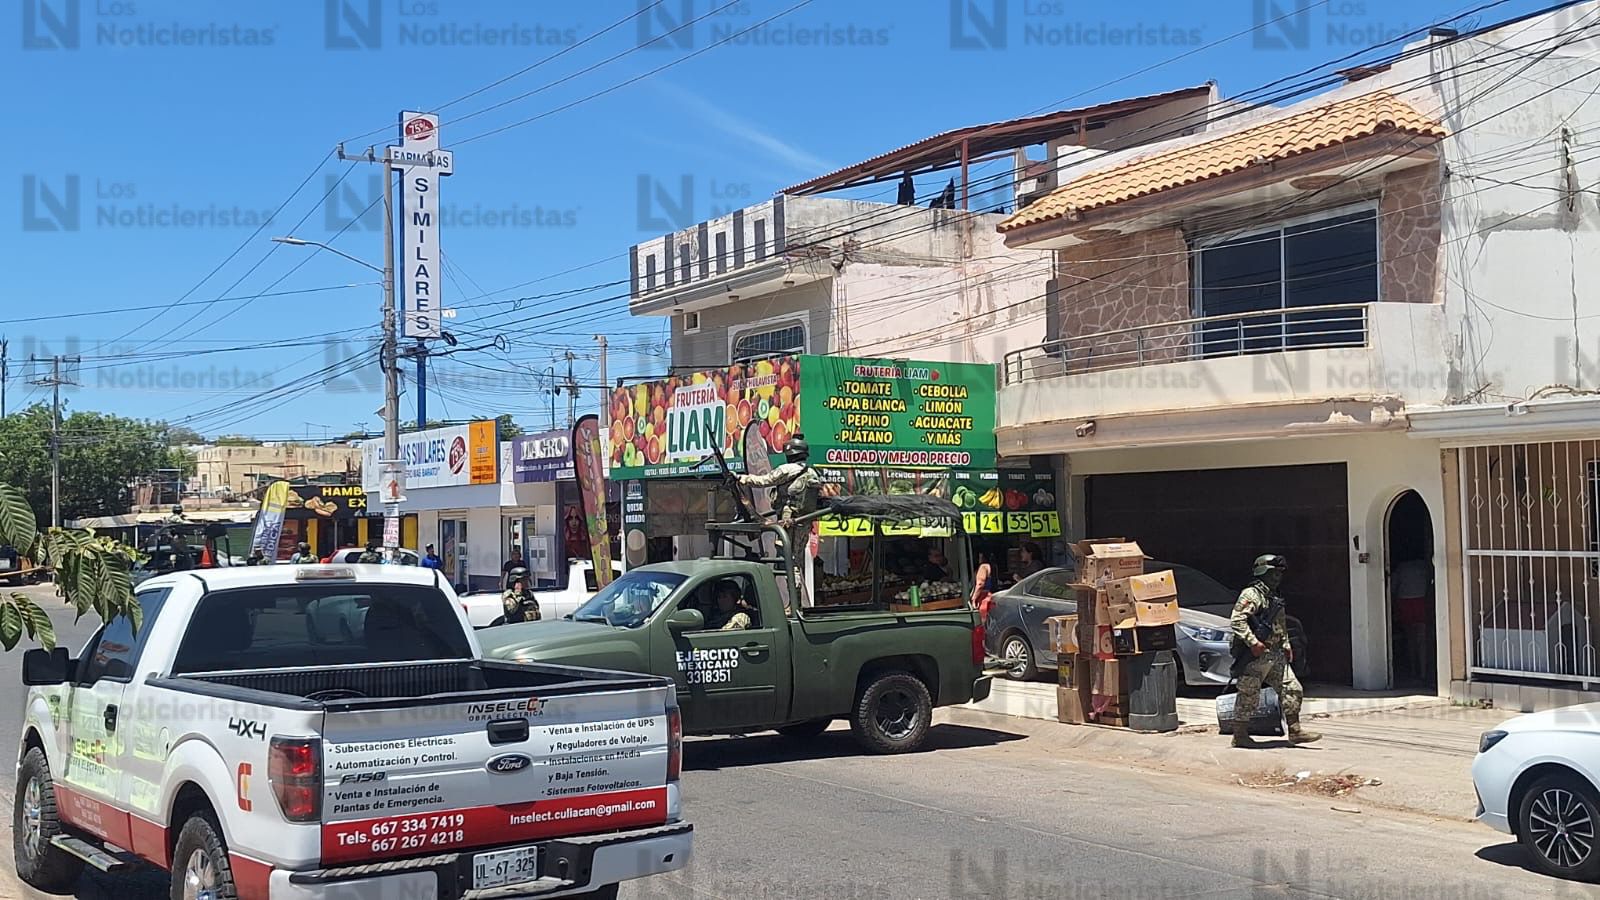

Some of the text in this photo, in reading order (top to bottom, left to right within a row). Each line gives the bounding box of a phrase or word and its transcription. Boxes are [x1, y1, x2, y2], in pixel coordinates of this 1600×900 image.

[413, 178, 430, 330] SIMILARES
[854, 365, 928, 379] FRUTERÍA LIAM
[676, 383, 716, 408] FRUTERÍA
[844, 382, 892, 396] TOMATE
[920, 385, 967, 398] CEBOLLA
[829, 397, 906, 412] PAPA BLANCA
[925, 400, 962, 413] LIMÓN
[847, 414, 890, 427] PEPINO
[915, 417, 972, 430] AGUACATE
[668, 406, 724, 452] LIAM
[841, 429, 893, 444] PLÁTANO
[927, 431, 961, 445] Y MÁS
[412, 439, 446, 465] SIMILARES
[827, 449, 970, 465] CALIDAD Y MEJOR PRECIO
[1010, 514, 1029, 530] 33
[1031, 514, 1051, 532] 59
[676, 647, 739, 662] EJÉRCITO
[678, 660, 738, 671] MEXICANO
[686, 669, 731, 684] 3318351
[467, 698, 549, 714] INSELECT
[468, 714, 492, 722] OBRA
[228, 717, 267, 741] 4X4
[549, 726, 572, 735] Venta
[582, 721, 625, 732] Instalación
[627, 720, 636, 729] de
[638, 719, 655, 728] UPS
[335, 740, 406, 754] Subestaciones
[550, 735, 650, 752] y Reguladores de Voltaje.
[336, 752, 458, 770] Automatización y Control.
[497, 757, 524, 770] Ford
[550, 754, 603, 766] Instalaciones
[548, 767, 610, 783] y Baja Tensión.
[335, 790, 362, 800] Venta
[374, 782, 426, 797] Instalación
[428, 783, 440, 792] de
[546, 785, 584, 796] Sistemas
[334, 795, 445, 814] Plantas de Emergencia.
[510, 800, 656, 825] Inselect.culiacan@gmail.com
[371, 814, 464, 836] 667 334 7419
[337, 832, 371, 846] Tels.
[371, 830, 464, 852] 667 267 4218
[476, 856, 535, 880] UL-67-325
